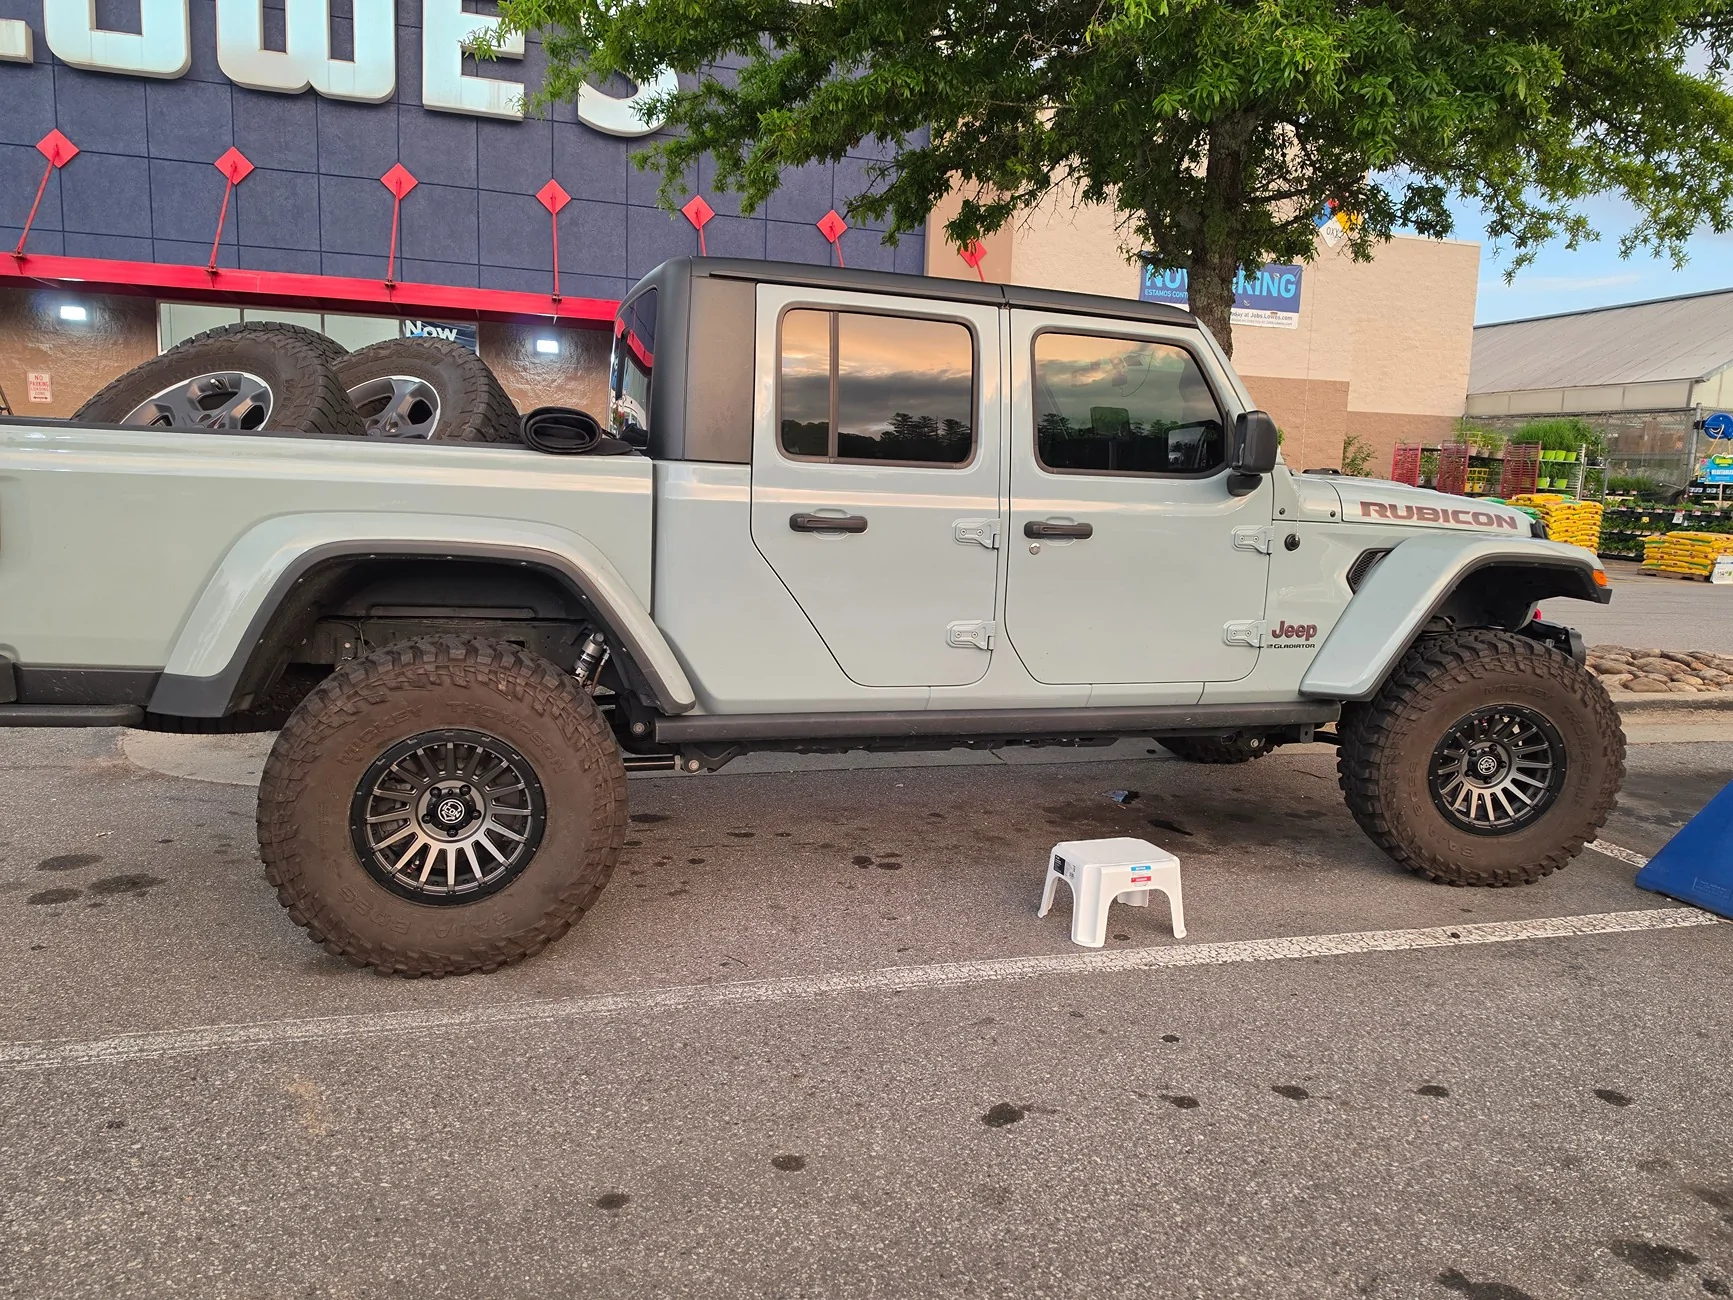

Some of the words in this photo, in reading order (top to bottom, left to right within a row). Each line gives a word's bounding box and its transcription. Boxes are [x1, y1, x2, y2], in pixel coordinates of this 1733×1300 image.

[1144, 288, 1172, 297] ESTAMOS
[1172, 291, 1189, 299] CONT
[405, 320, 458, 341] Now
[1360, 500, 1519, 530] RUBICON
[1271, 620, 1318, 641] Jeep
[336, 704, 424, 765] MICKEY
[441, 803, 462, 818] ICON
